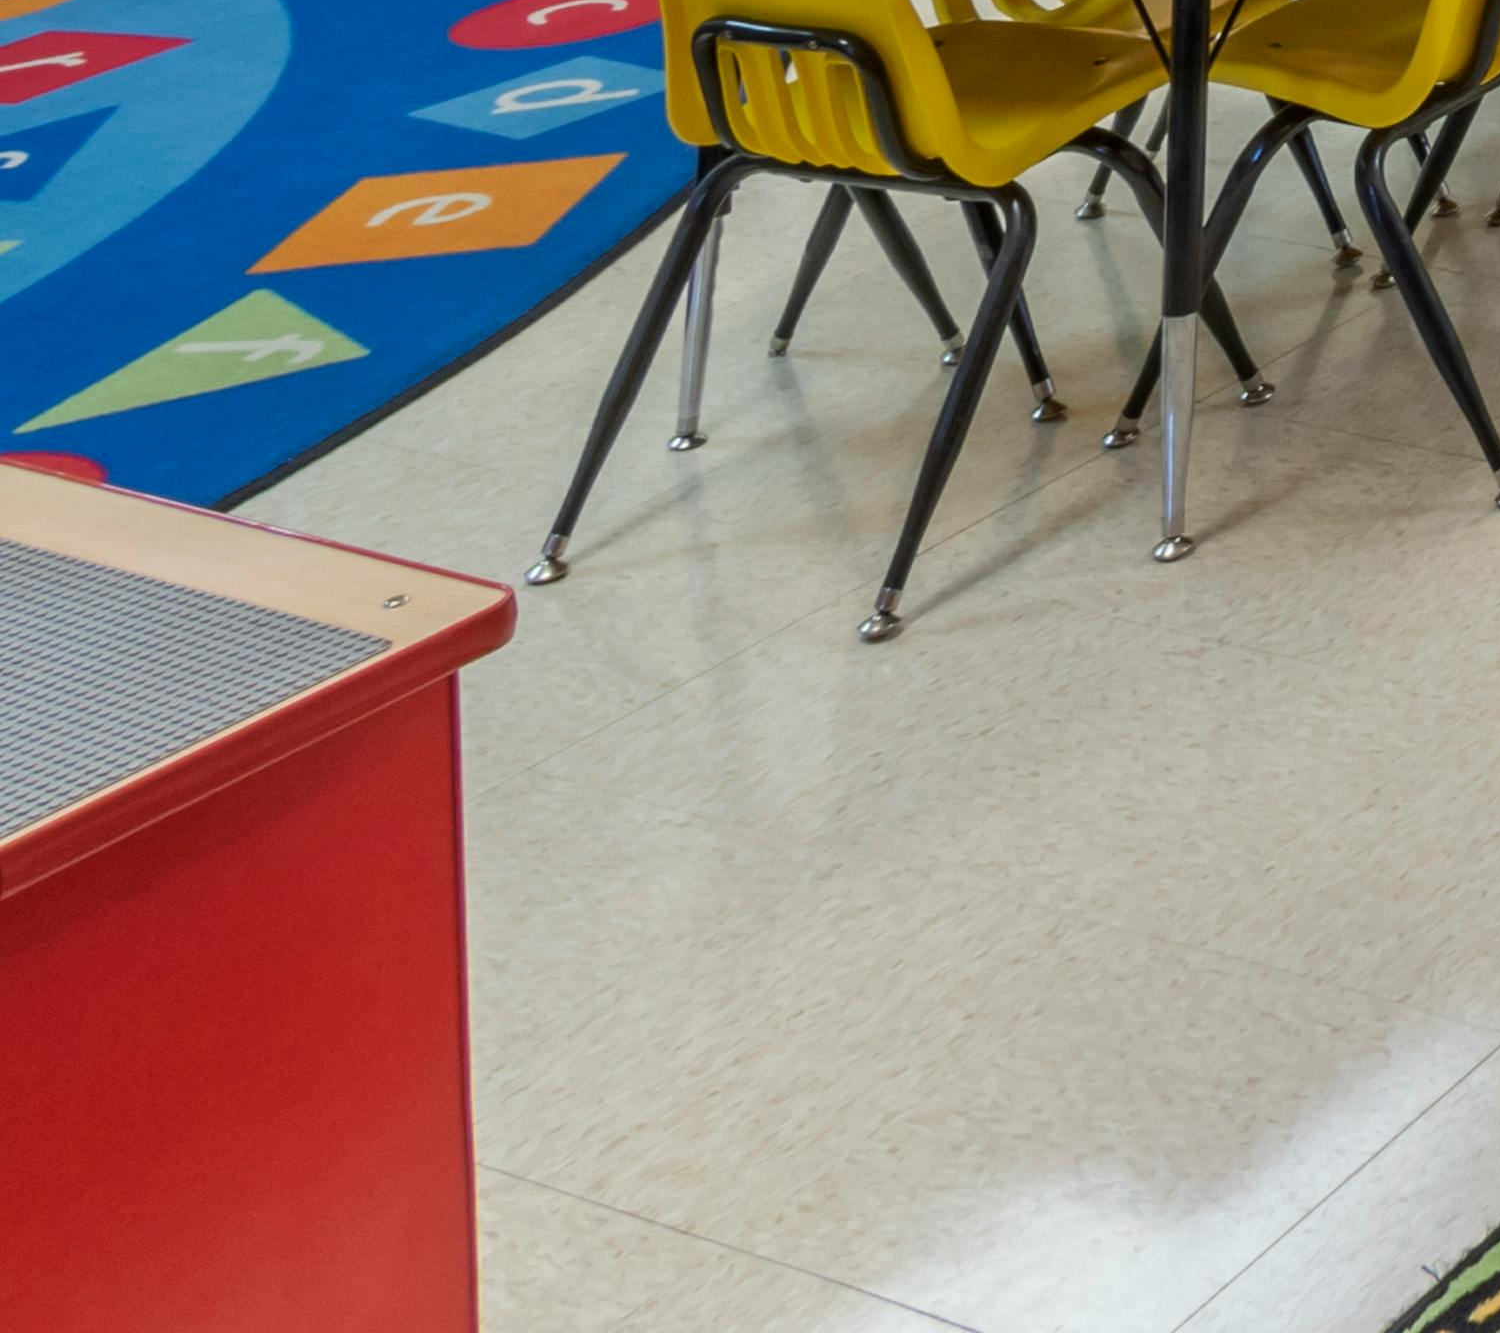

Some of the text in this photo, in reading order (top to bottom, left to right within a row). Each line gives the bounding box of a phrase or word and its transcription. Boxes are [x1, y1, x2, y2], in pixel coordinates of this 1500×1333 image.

[493, 77, 640, 117] d
[365, 190, 493, 228] e
[172, 332, 326, 364] f
